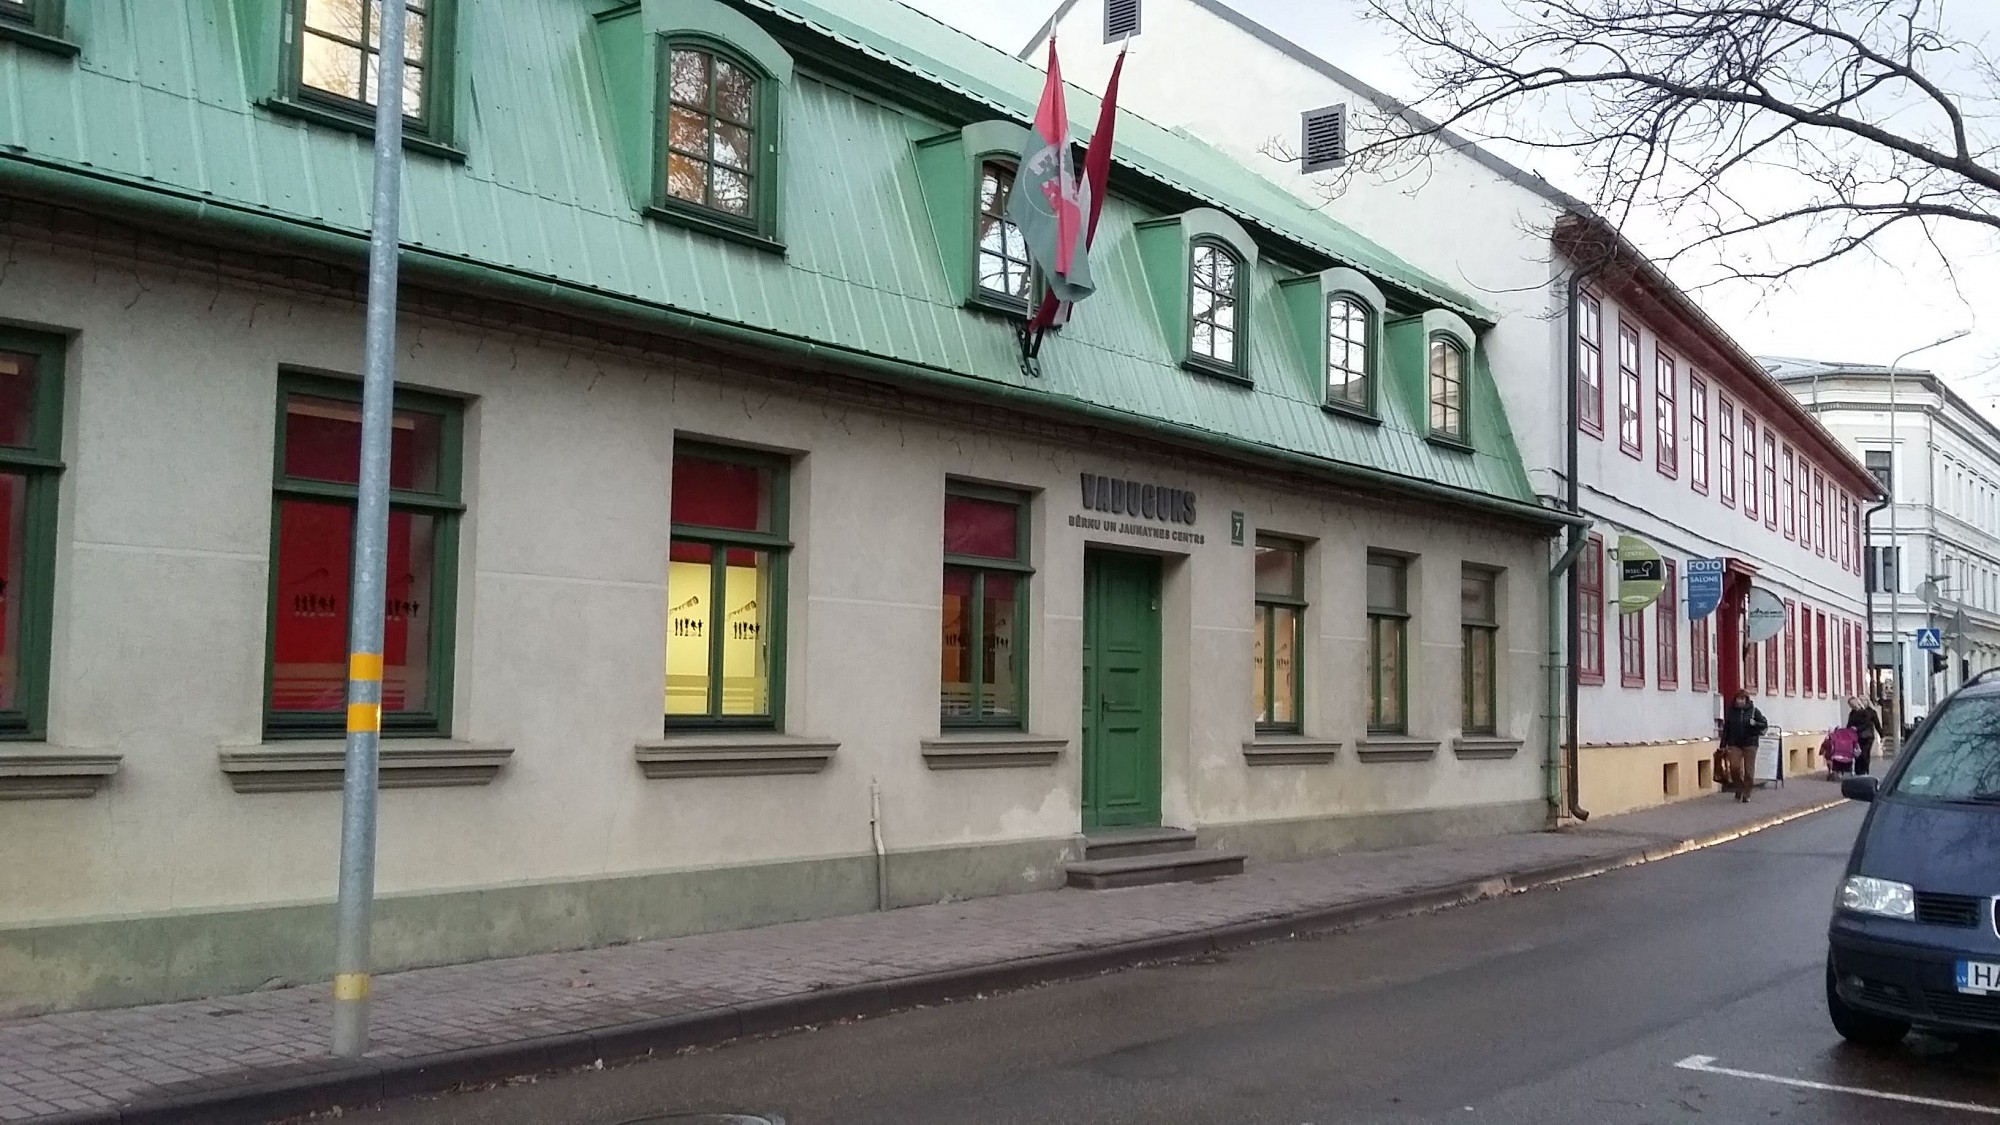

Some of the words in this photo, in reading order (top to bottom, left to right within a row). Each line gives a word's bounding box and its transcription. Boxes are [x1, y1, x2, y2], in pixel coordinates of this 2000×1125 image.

[1080, 472, 1197, 525] VADUGUNS
[1103, 520, 1117, 533] UN
[1171, 530, 1205, 545] CENTRS
[1235, 522, 1241, 537] 7
[1688, 560, 1722, 571] FOTO
